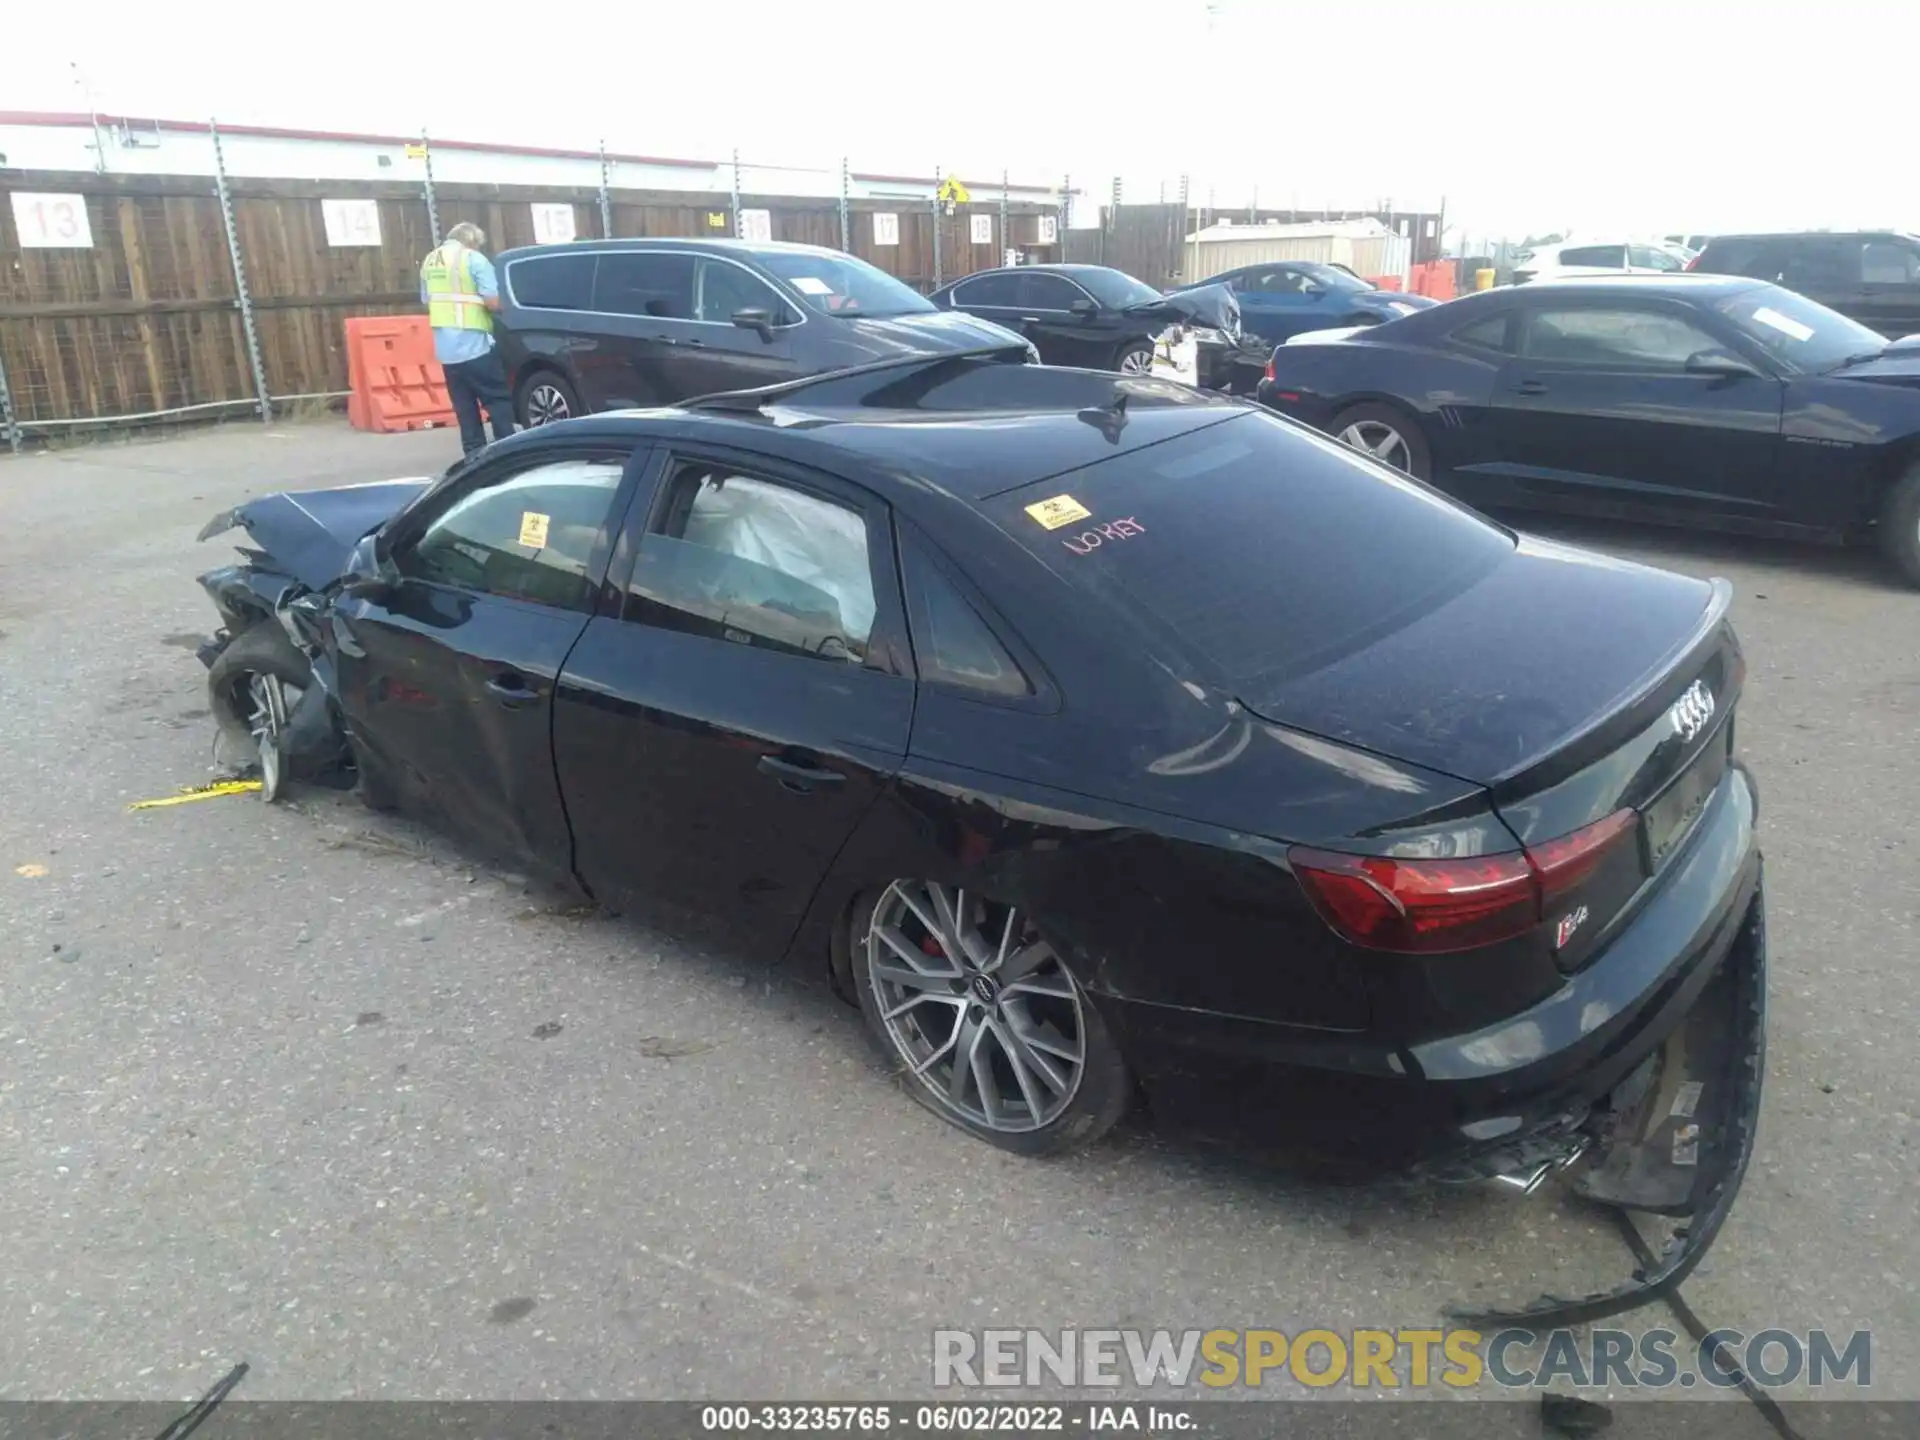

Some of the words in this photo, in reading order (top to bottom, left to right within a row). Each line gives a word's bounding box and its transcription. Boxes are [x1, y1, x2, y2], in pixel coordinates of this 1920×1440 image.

[30, 201, 78, 239] 13
[338, 206, 372, 239] 14
[541, 209, 569, 238] 15
[879, 216, 896, 239] 17
[975, 218, 989, 239] 18
[1042, 218, 1055, 239] 19
